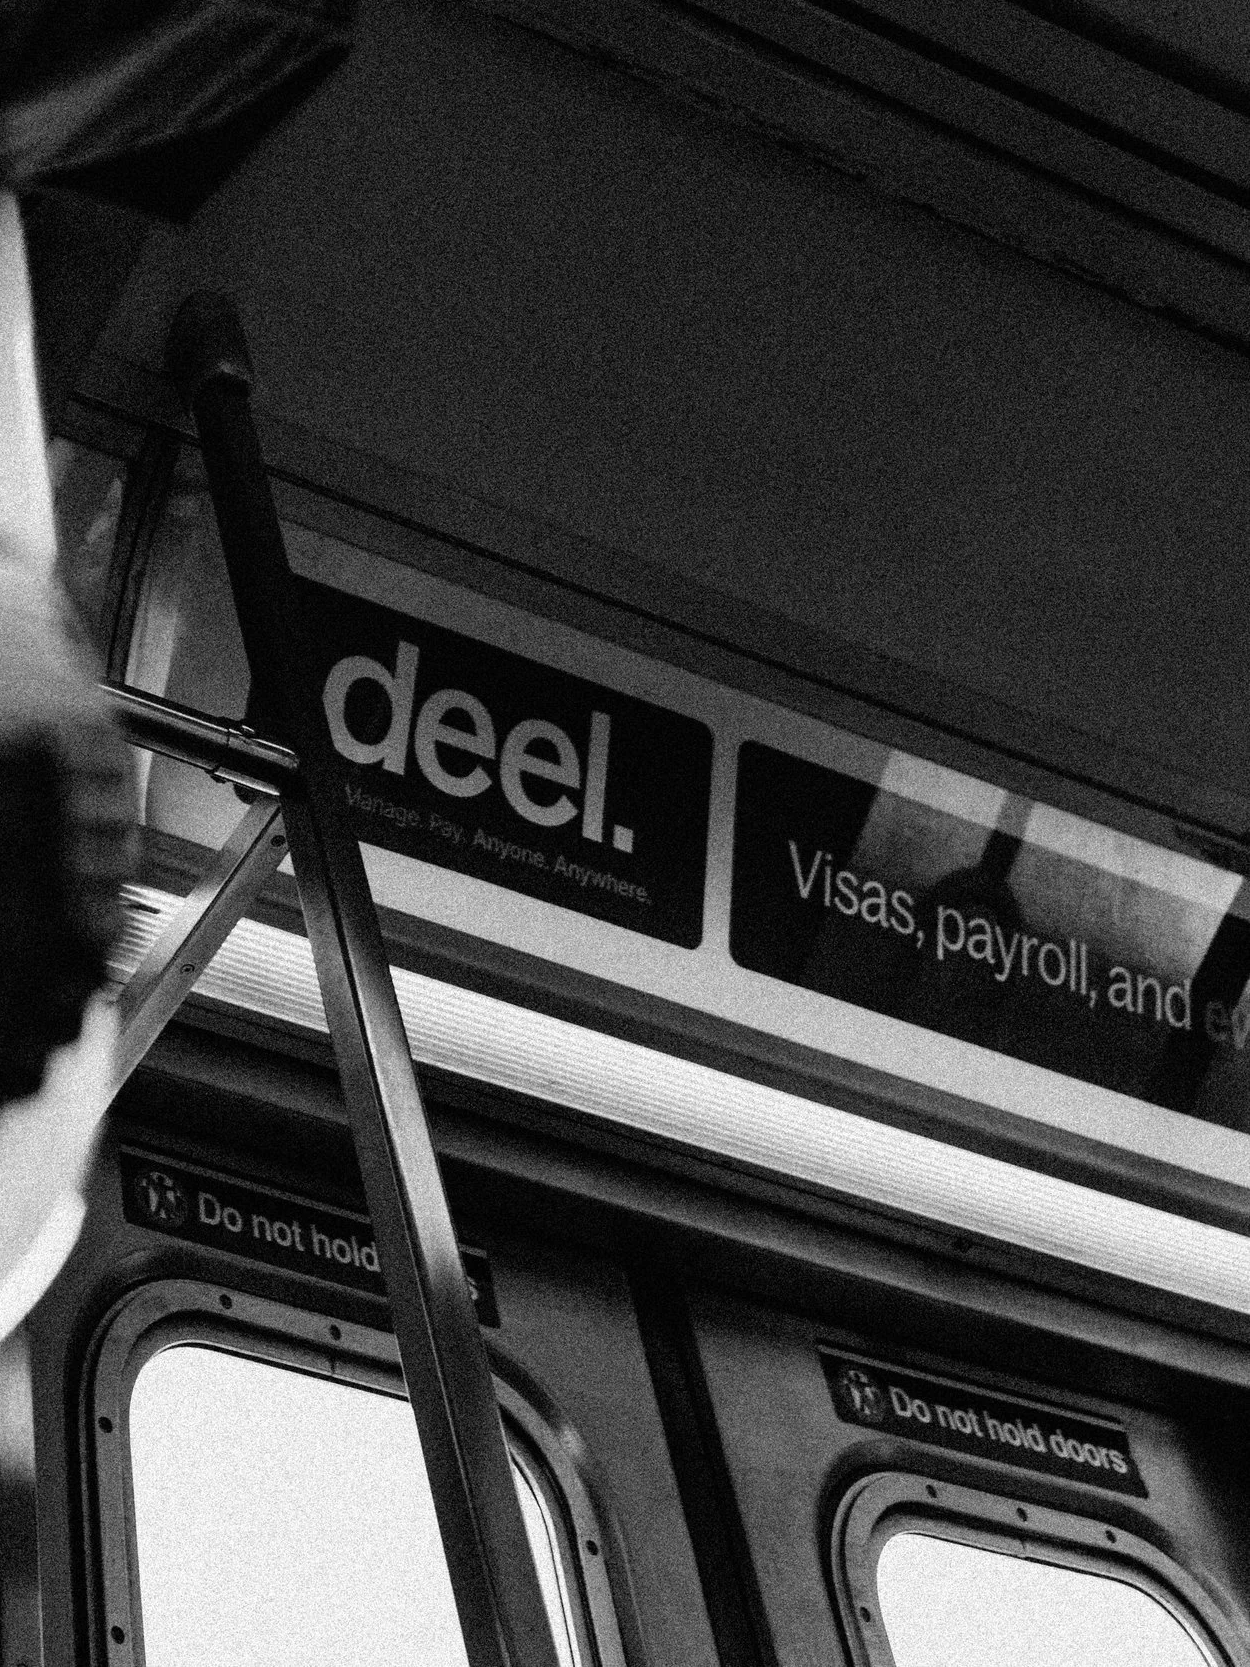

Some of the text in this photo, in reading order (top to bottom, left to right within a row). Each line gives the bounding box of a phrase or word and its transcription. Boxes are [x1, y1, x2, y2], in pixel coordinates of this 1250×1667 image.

[322, 640, 634, 853] deel.
[553, 854, 653, 905] Anywhere.
[788, 839, 925, 949] Visas,
[936, 904, 1097, 1009] payroll,
[1107, 965, 1192, 1031] and
[198, 1192, 382, 1273] Do not hold
[888, 1385, 1130, 1475] Do not hold doors
